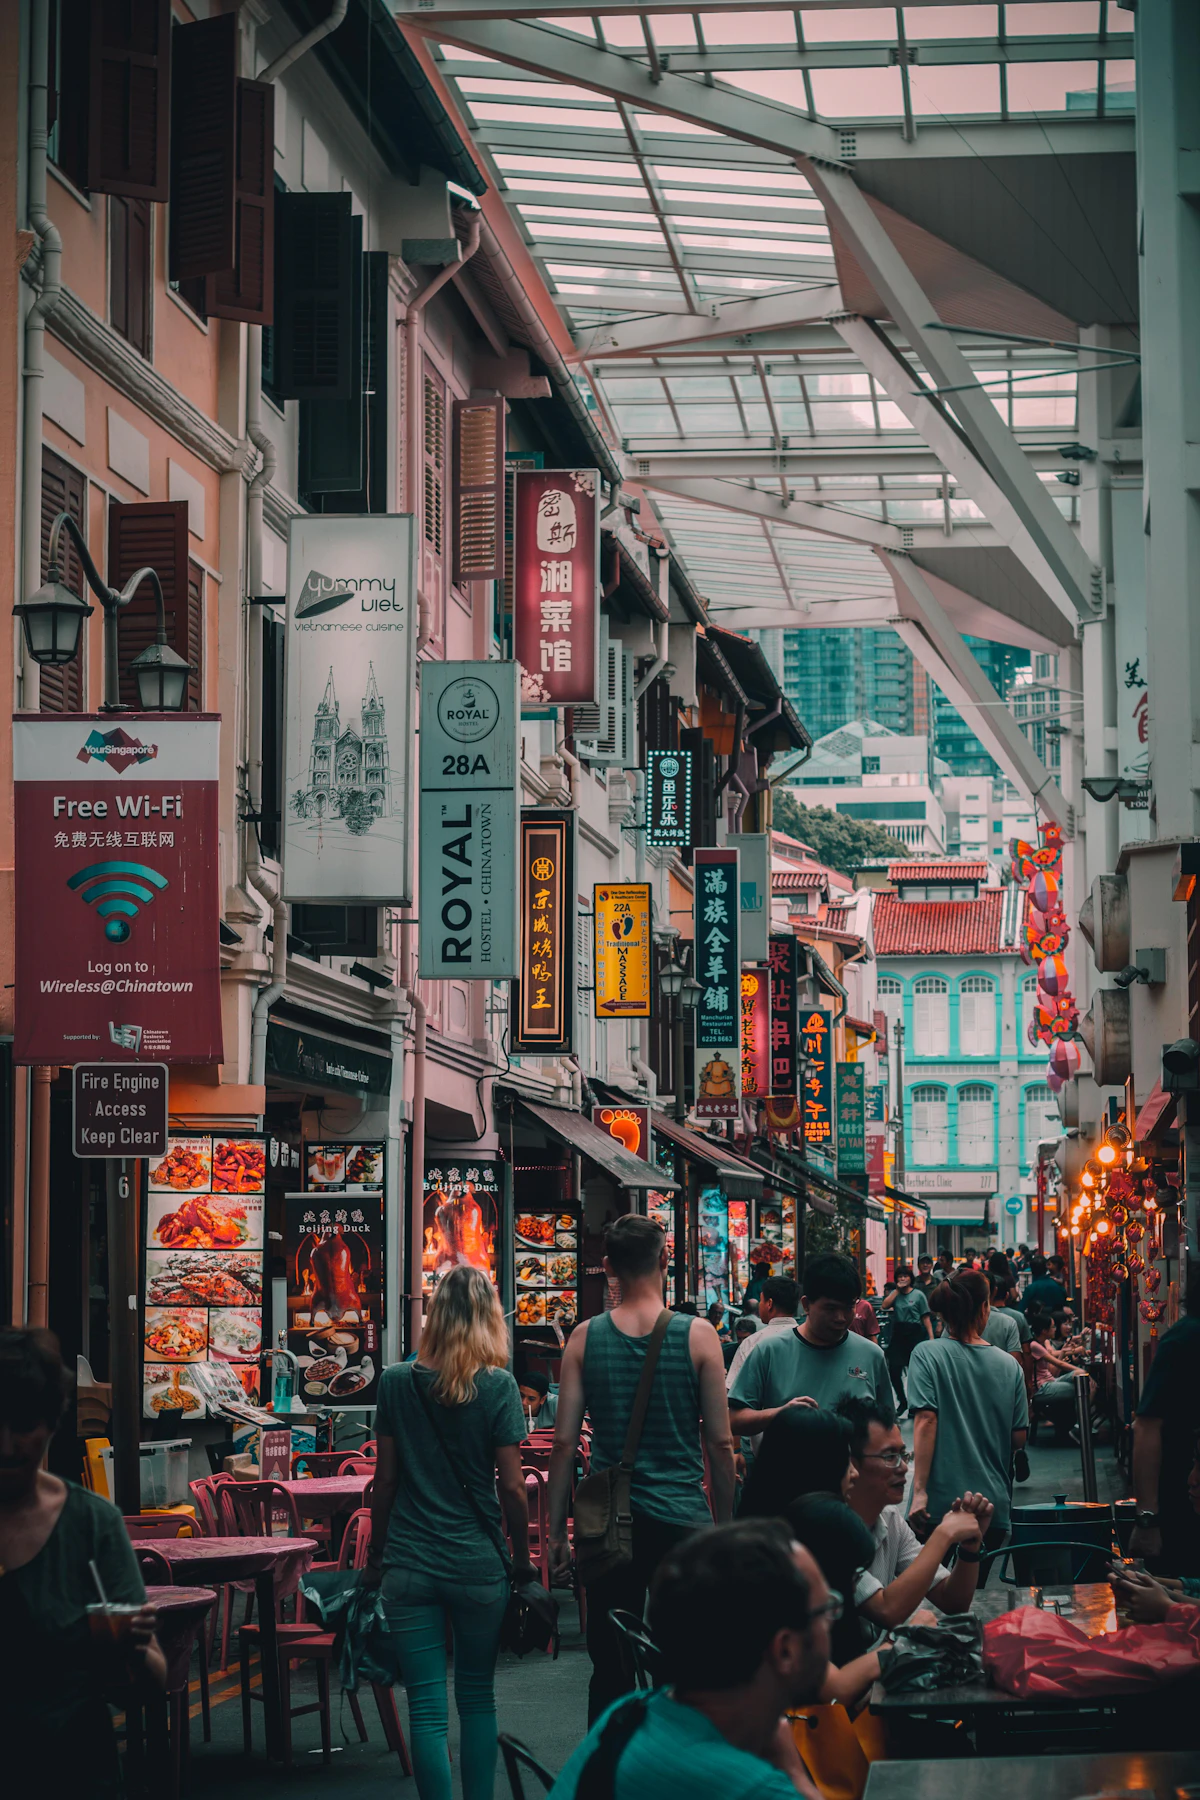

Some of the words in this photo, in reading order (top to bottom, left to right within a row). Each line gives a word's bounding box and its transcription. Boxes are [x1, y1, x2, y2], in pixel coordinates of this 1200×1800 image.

[308, 577, 396, 597] yummy
[361, 597, 404, 612] viet
[539, 560, 573, 672] 湘菜馆
[294, 619, 363, 632] vietnamese
[365, 622, 404, 632] cuisine
[447, 709, 489, 720] ROYAL
[84, 744, 155, 756] YourSingapore
[442, 754, 491, 776] 28A
[53, 795, 108, 818] Free
[115, 794, 183, 818] Wi-Fi
[659, 778, 679, 827] 鱼乐乐
[53, 830, 175, 848] 免费无线互联网
[480, 802, 492, 895] CHINATOWN
[441, 803, 472, 963] ROYAL
[613, 903, 631, 912] 22A
[480, 908, 492, 963] HOSTEL
[87, 960, 112, 976] Log
[114, 963, 132, 974] on
[134, 961, 149, 974] to
[617, 947, 629, 1001] MASSAGE
[39, 978, 194, 995] Wireless@Chinatown
[63, 1033, 92, 1042] Supported
[81, 1073, 109, 1090] Fire
[113, 1073, 160, 1094] Engine
[95, 1100, 147, 1117] Access
[81, 1128, 116, 1148] Keep
[120, 1128, 160, 1144] Clear
[848, 1137, 863, 1148] YAN
[423, 1182, 470, 1193] Beijing
[475, 1183, 499, 1193] Duck
[298, 1224, 339, 1235] Beijing
[343, 1223, 371, 1233] Duck
